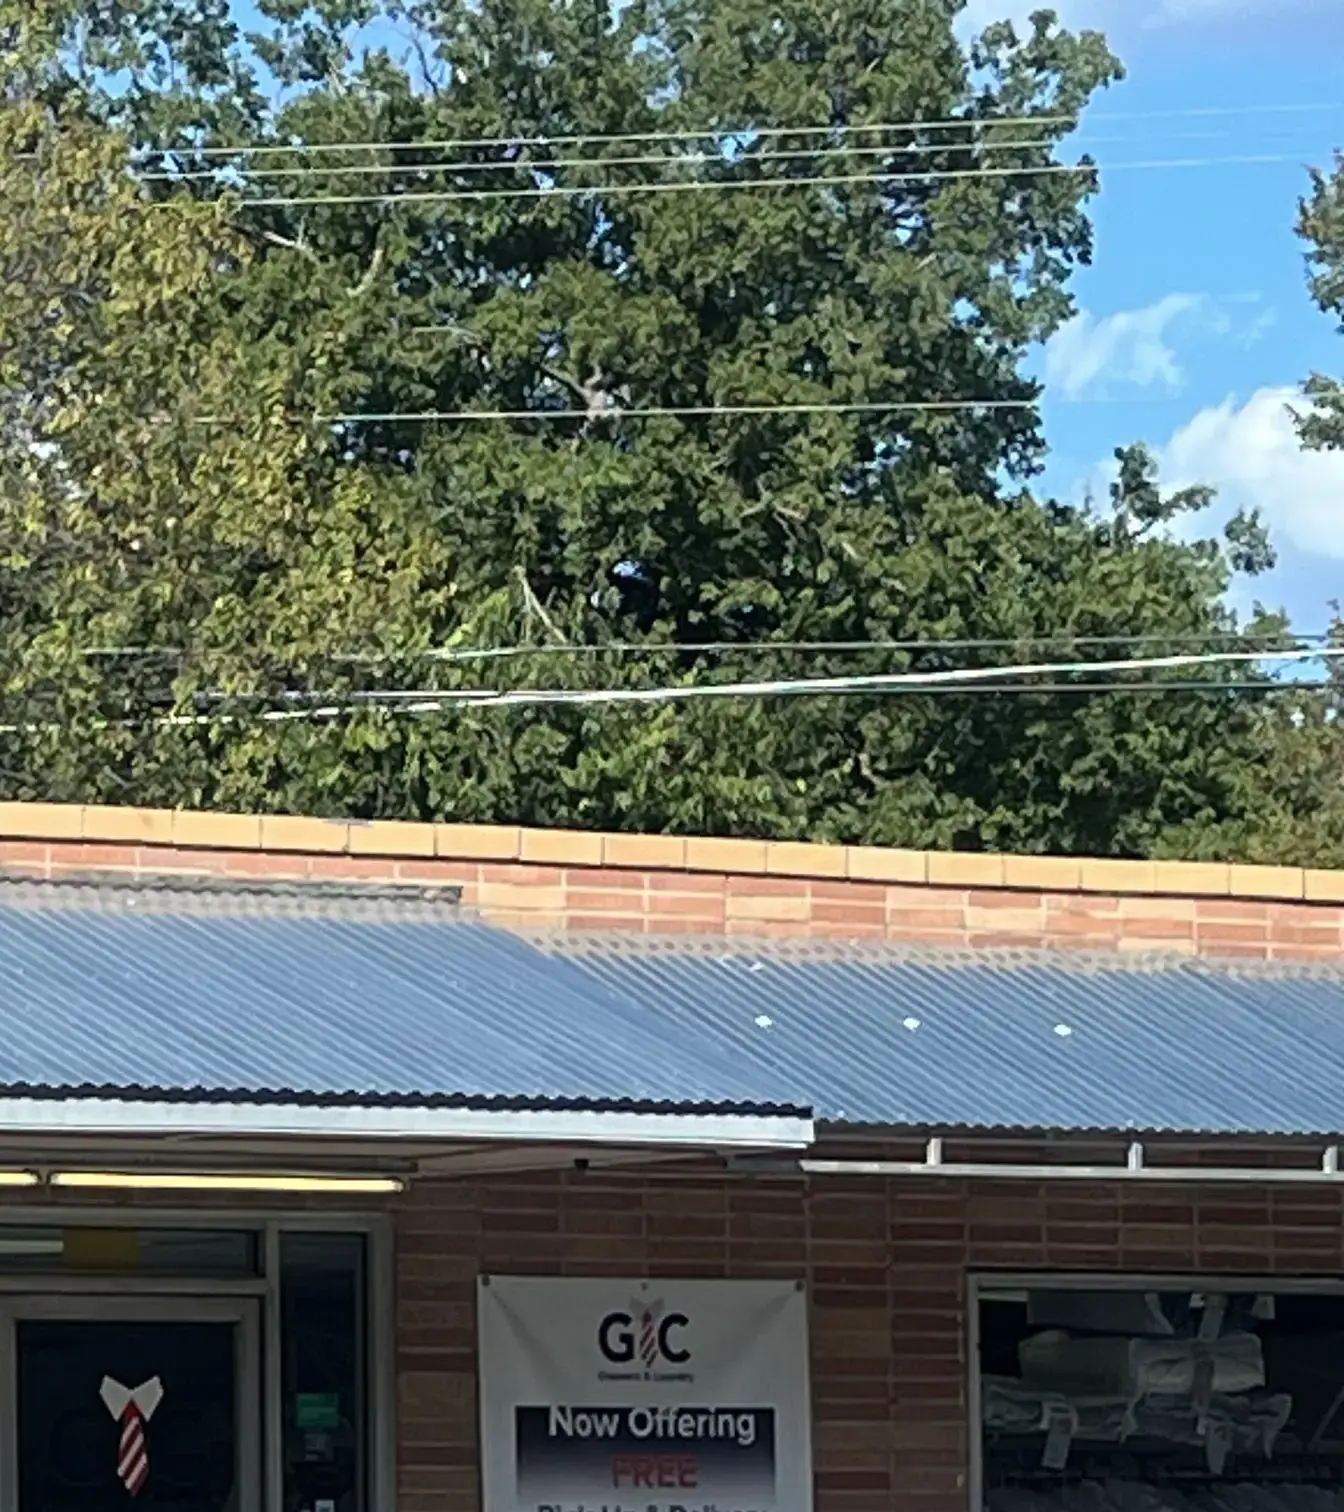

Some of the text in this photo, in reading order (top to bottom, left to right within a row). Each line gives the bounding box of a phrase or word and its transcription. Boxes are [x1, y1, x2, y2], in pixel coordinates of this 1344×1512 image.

[548, 1407, 755, 1445] Now Offering
[612, 1454, 699, 1489] FREE
